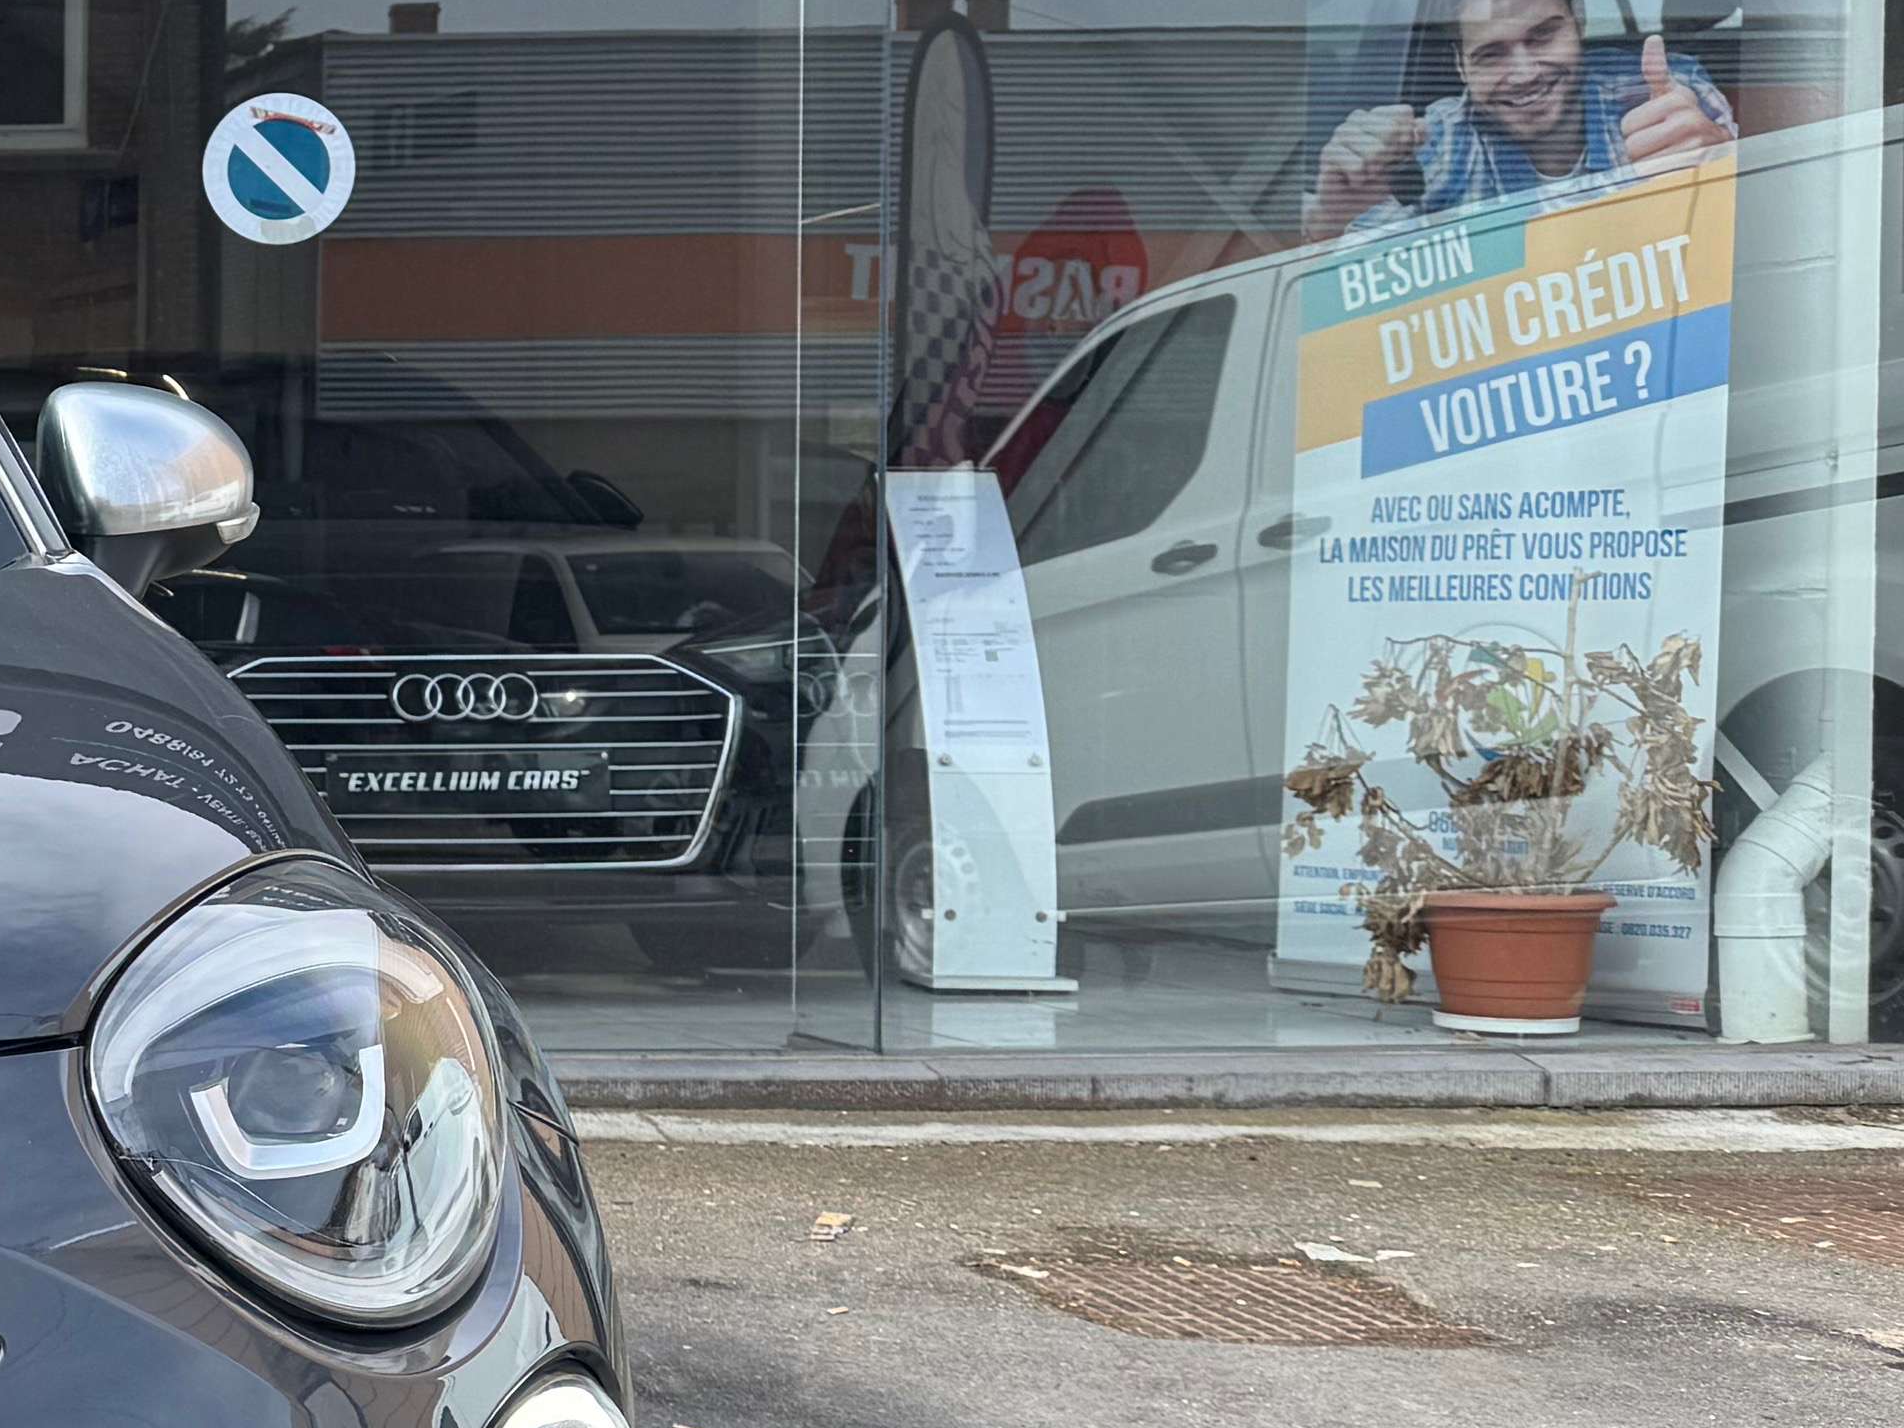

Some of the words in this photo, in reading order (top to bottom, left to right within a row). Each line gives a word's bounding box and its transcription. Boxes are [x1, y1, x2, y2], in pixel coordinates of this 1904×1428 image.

[1339, 224, 1474, 312] BESOIN
[1503, 234, 1692, 347] CRÉDIT
[1419, 350, 1618, 453] VOITURE
[1623, 339, 1653, 400] ?
[1371, 495, 1422, 523] AVEC
[1426, 494, 1453, 522] OU
[1458, 492, 1512, 521] SANS
[1518, 489, 1631, 520] ACOMPTE,
[1319, 537, 1344, 564] LA
[1349, 534, 1425, 563] MAISON
[1430, 533, 1457, 561] DU
[1462, 527, 1517, 561] PRÊT
[1522, 531, 1583, 560] VOUS
[1589, 529, 1689, 559] PROPOSE
[1348, 575, 1384, 603] LES
[1388, 573, 1513, 602] MEILLEURES
[347, 771, 501, 792] EXCELLIUM
[506, 769, 580, 790] CARS
